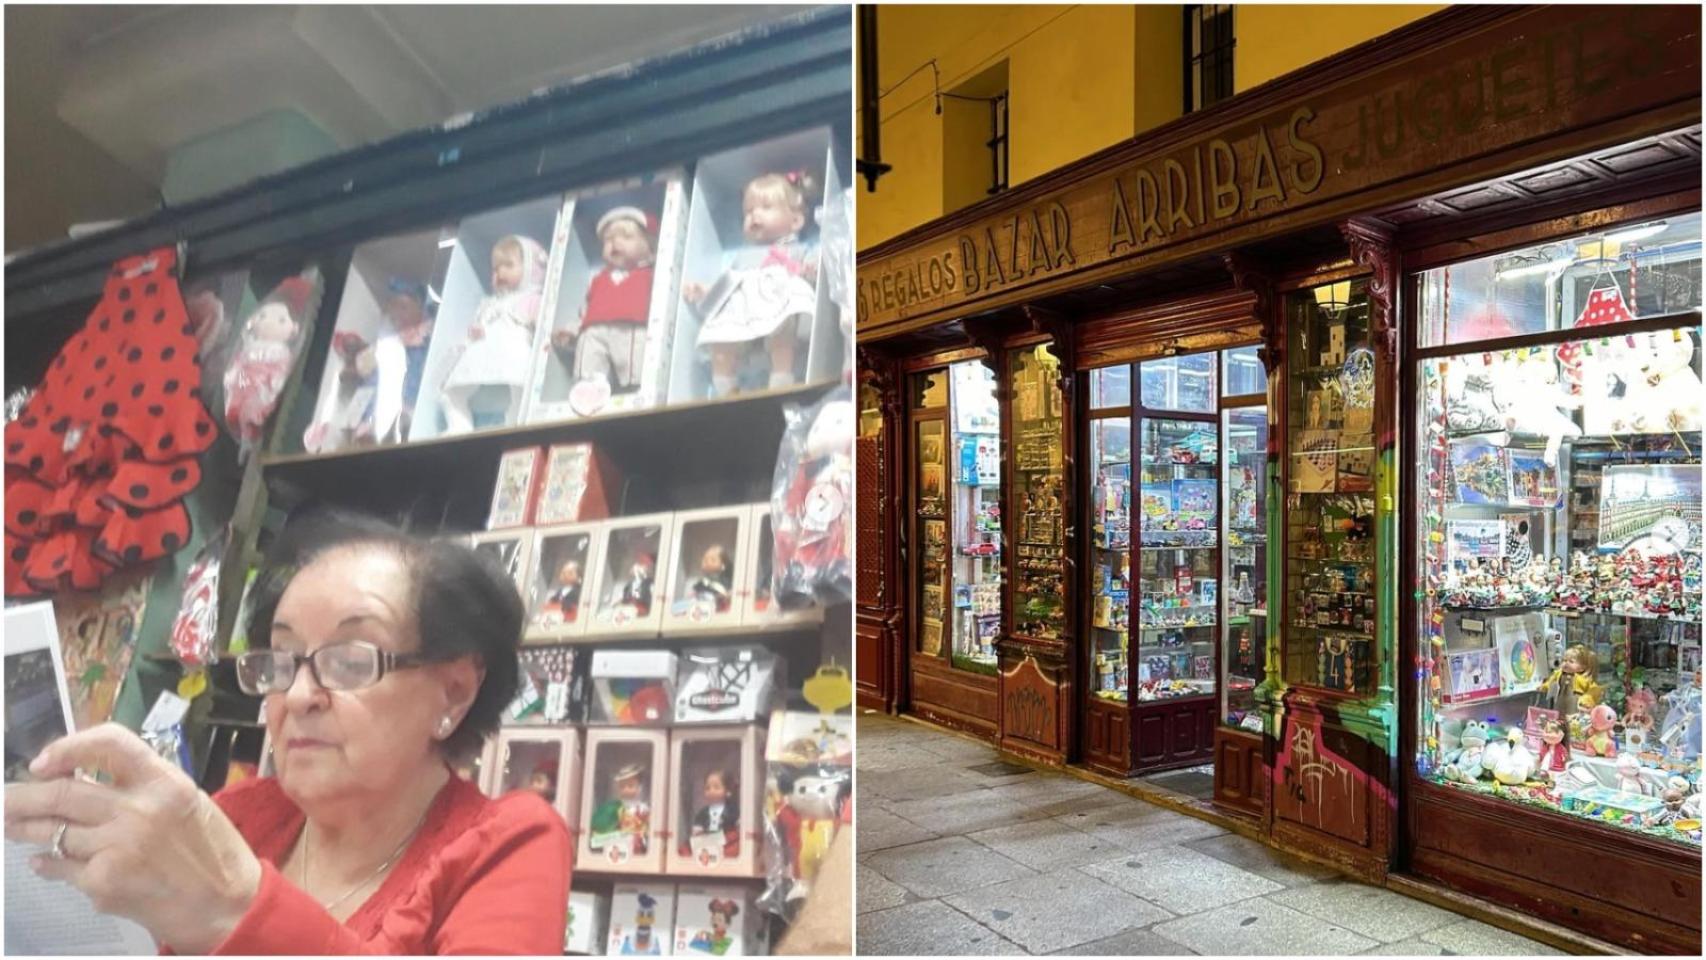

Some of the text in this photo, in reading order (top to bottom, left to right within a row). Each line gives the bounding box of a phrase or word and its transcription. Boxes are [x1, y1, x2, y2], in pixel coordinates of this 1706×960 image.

[870, 252, 956, 313] REGALOS
[959, 200, 1076, 297] BAZAR
[1108, 105, 1325, 253] ARRIBAS
[1343, 5, 1663, 168] JUGUETES
